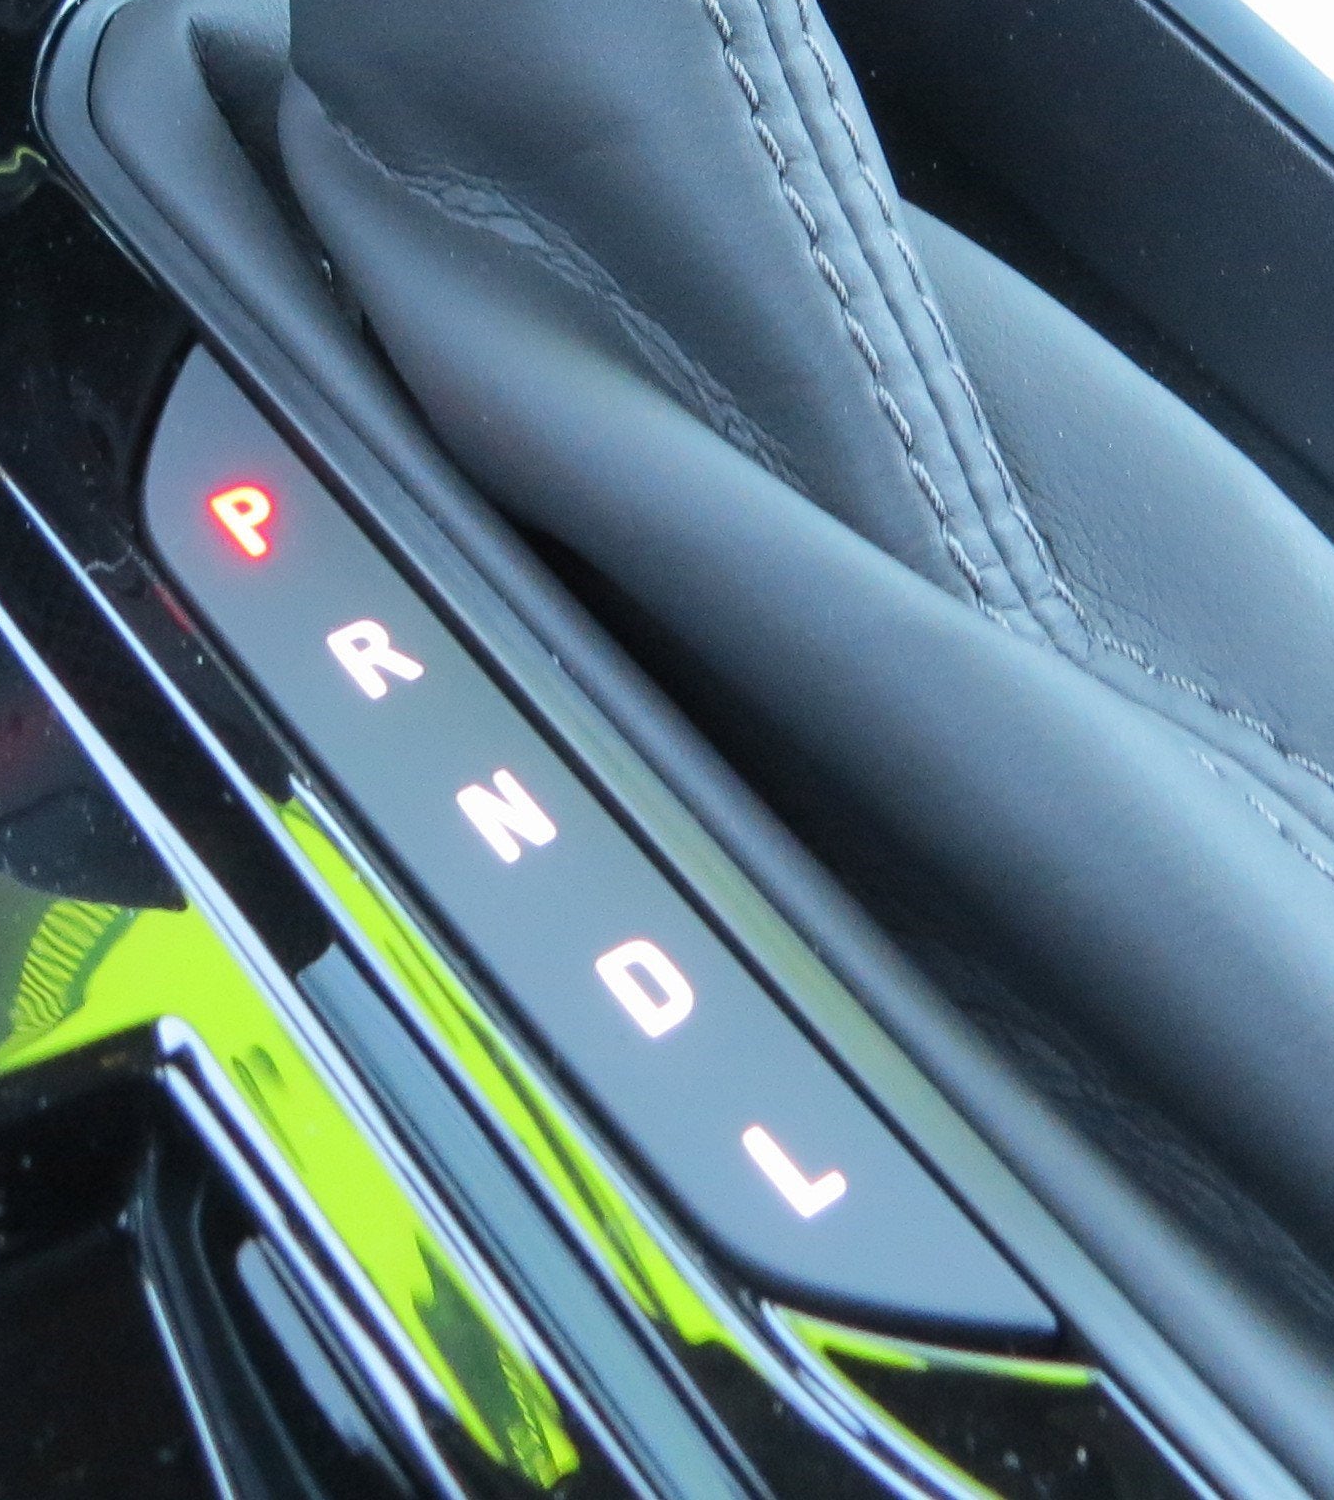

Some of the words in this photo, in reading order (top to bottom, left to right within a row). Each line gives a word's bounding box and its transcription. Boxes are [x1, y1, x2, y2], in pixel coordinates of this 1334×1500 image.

[208, 485, 273, 559] P
[326, 618, 426, 700] R
[455, 768, 558, 864] N
[593, 938, 696, 1040] D
[741, 1124, 848, 1219] L
